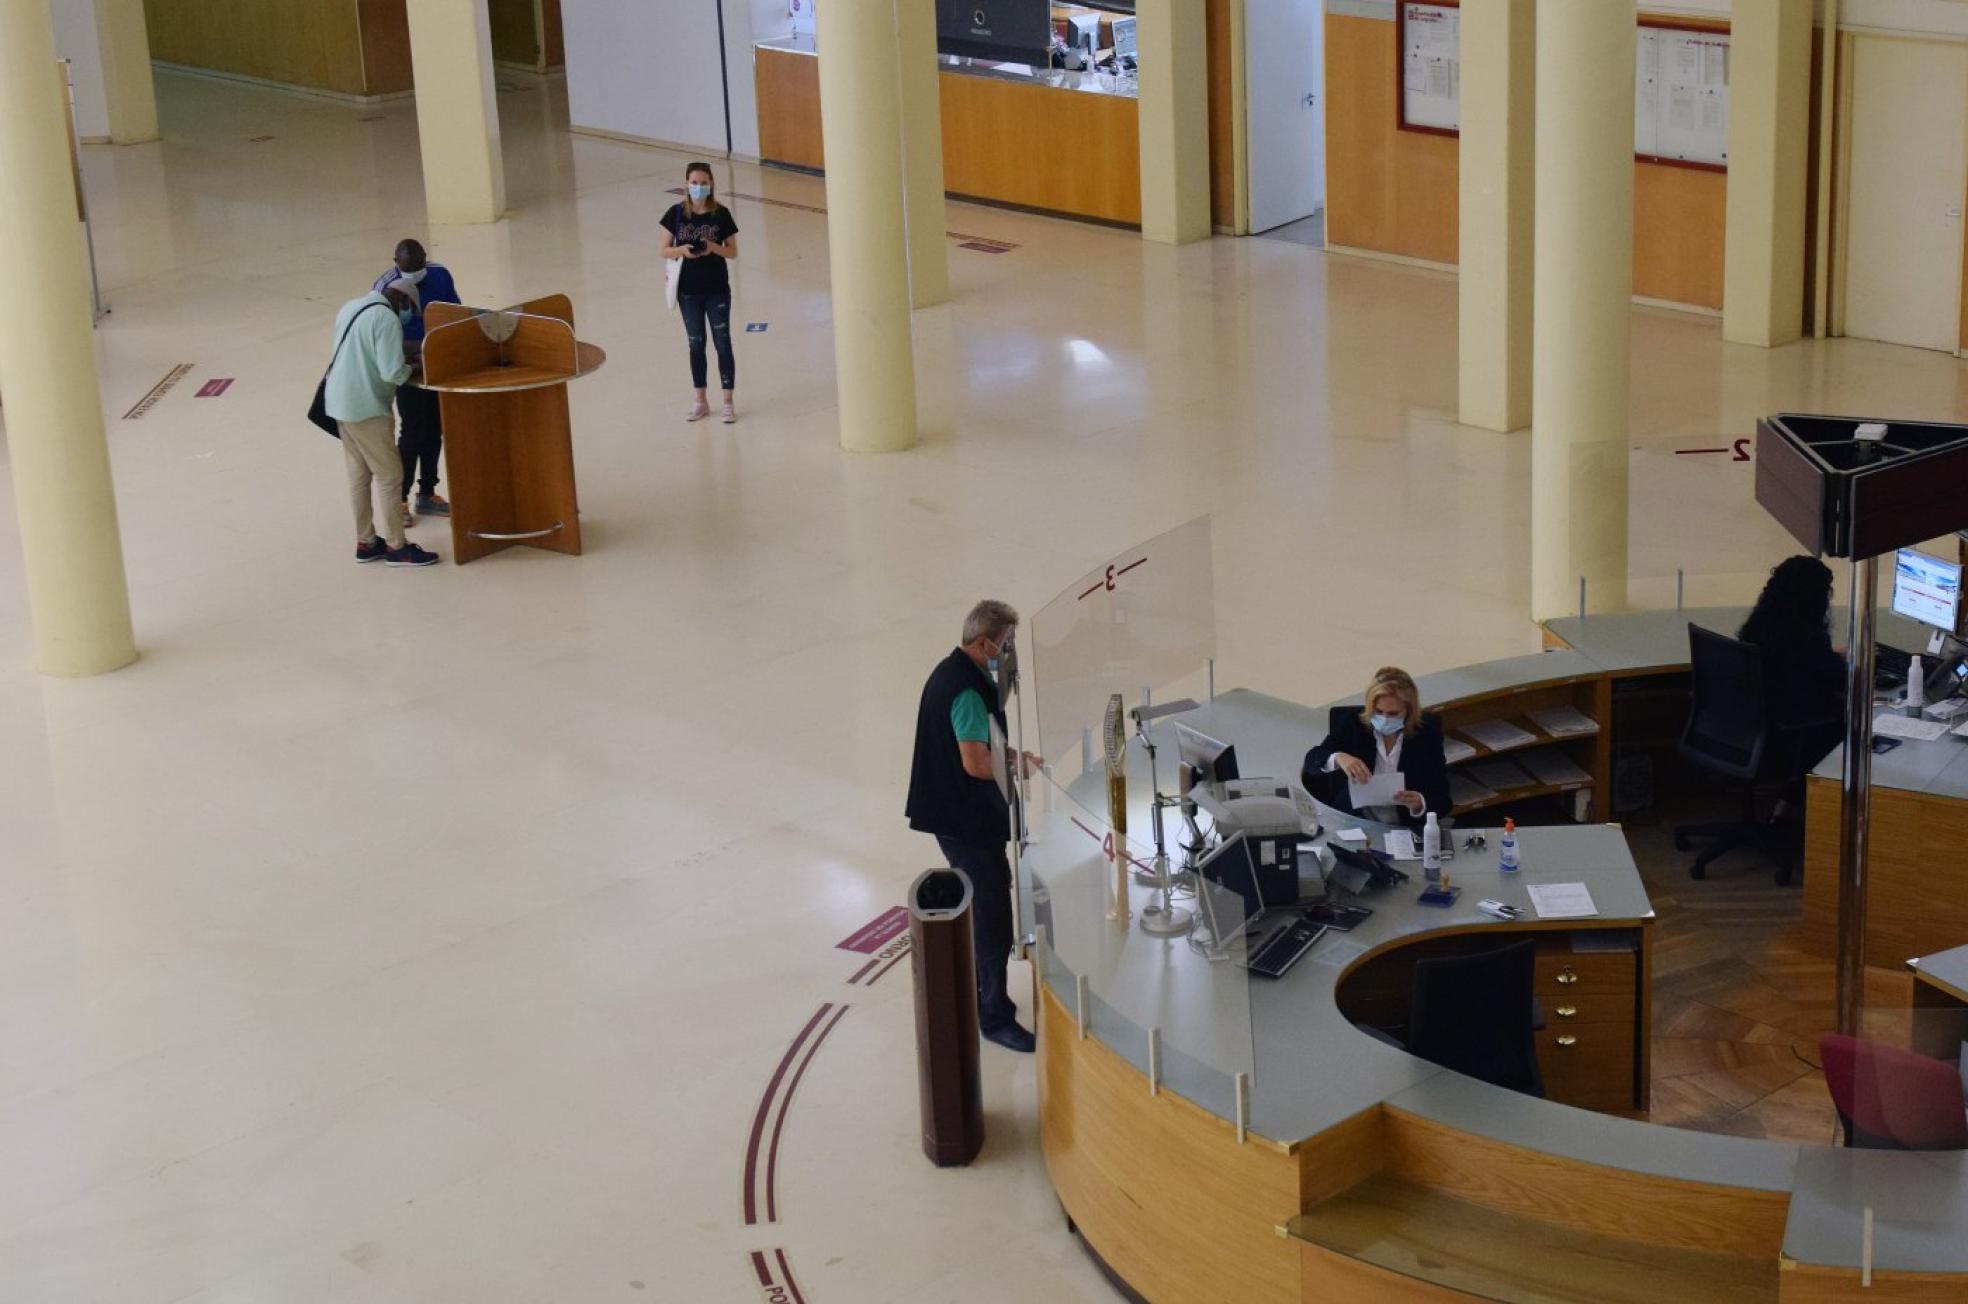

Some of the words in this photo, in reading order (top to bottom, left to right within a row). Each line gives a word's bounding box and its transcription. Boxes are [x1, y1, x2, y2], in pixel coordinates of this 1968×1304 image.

[1103, 832, 1115, 862] 4
[879, 934, 912, 958] URNO
[765, 1286, 789, 1304] PO
